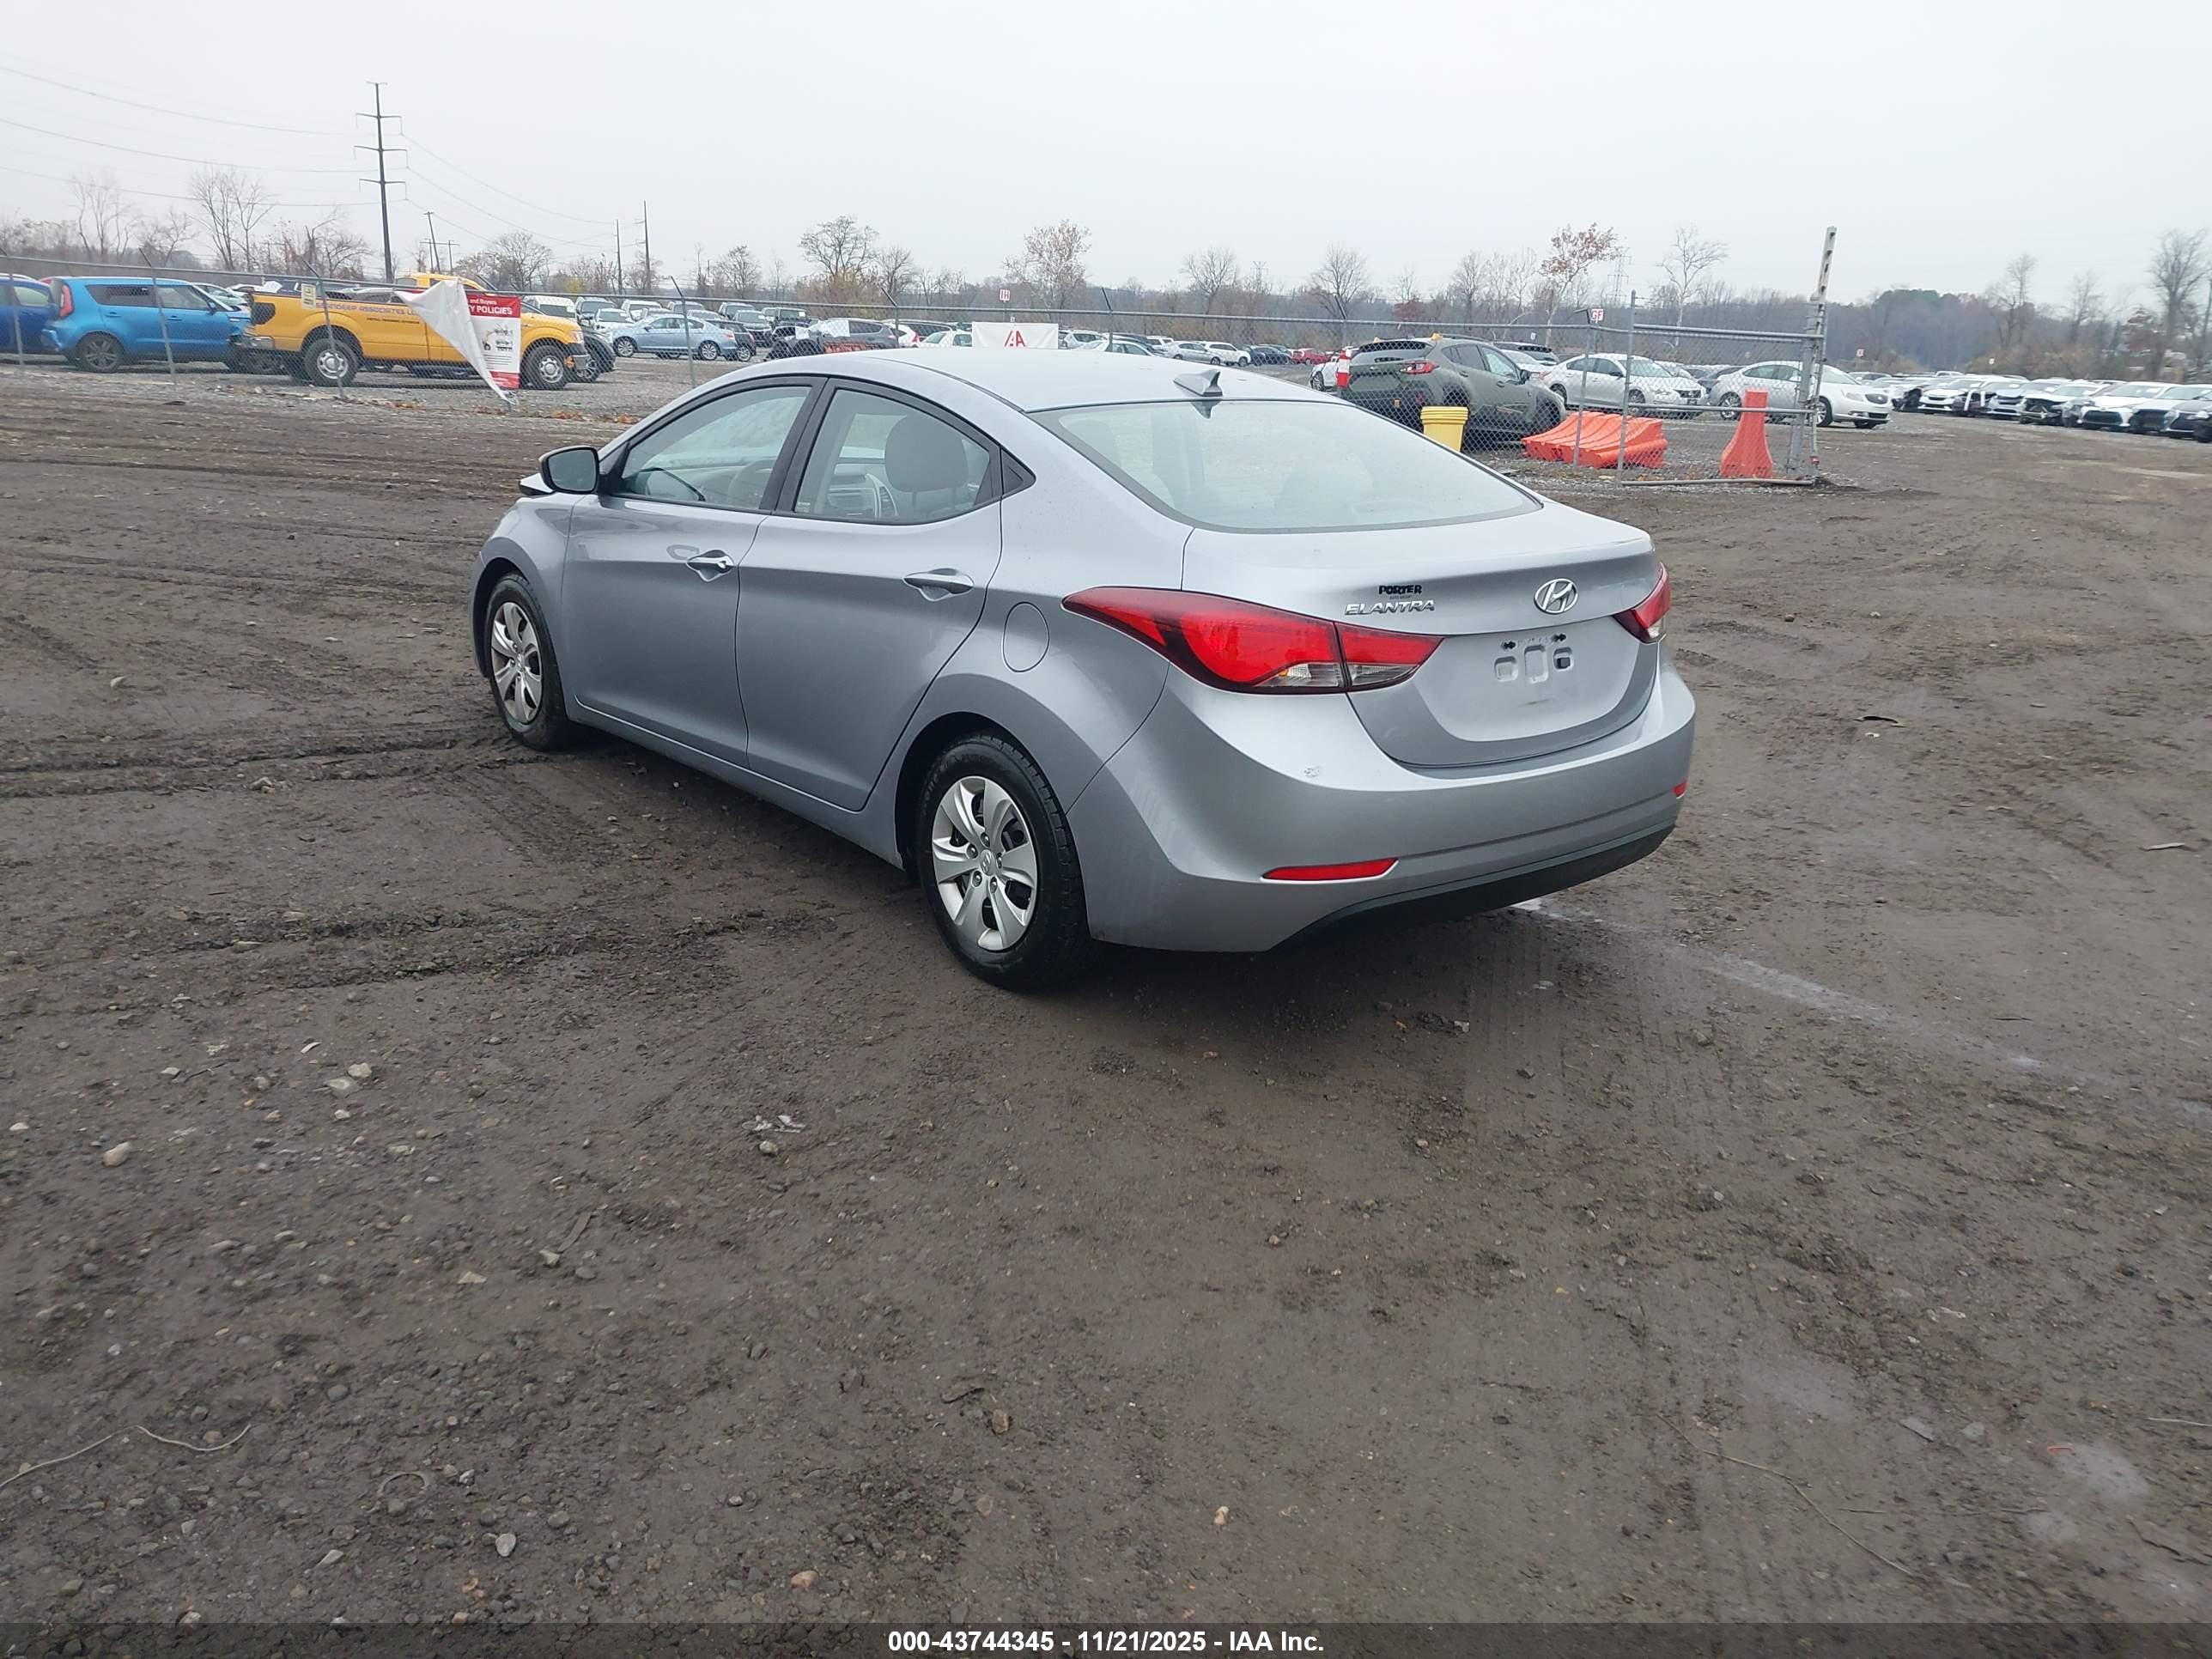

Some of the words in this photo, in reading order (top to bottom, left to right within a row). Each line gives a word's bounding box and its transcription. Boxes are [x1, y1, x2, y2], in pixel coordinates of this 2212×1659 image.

[477, 306, 513, 315] POLICIES
[1378, 585, 1423, 595] PORTER
[1345, 600, 1435, 616] ELANTRA
